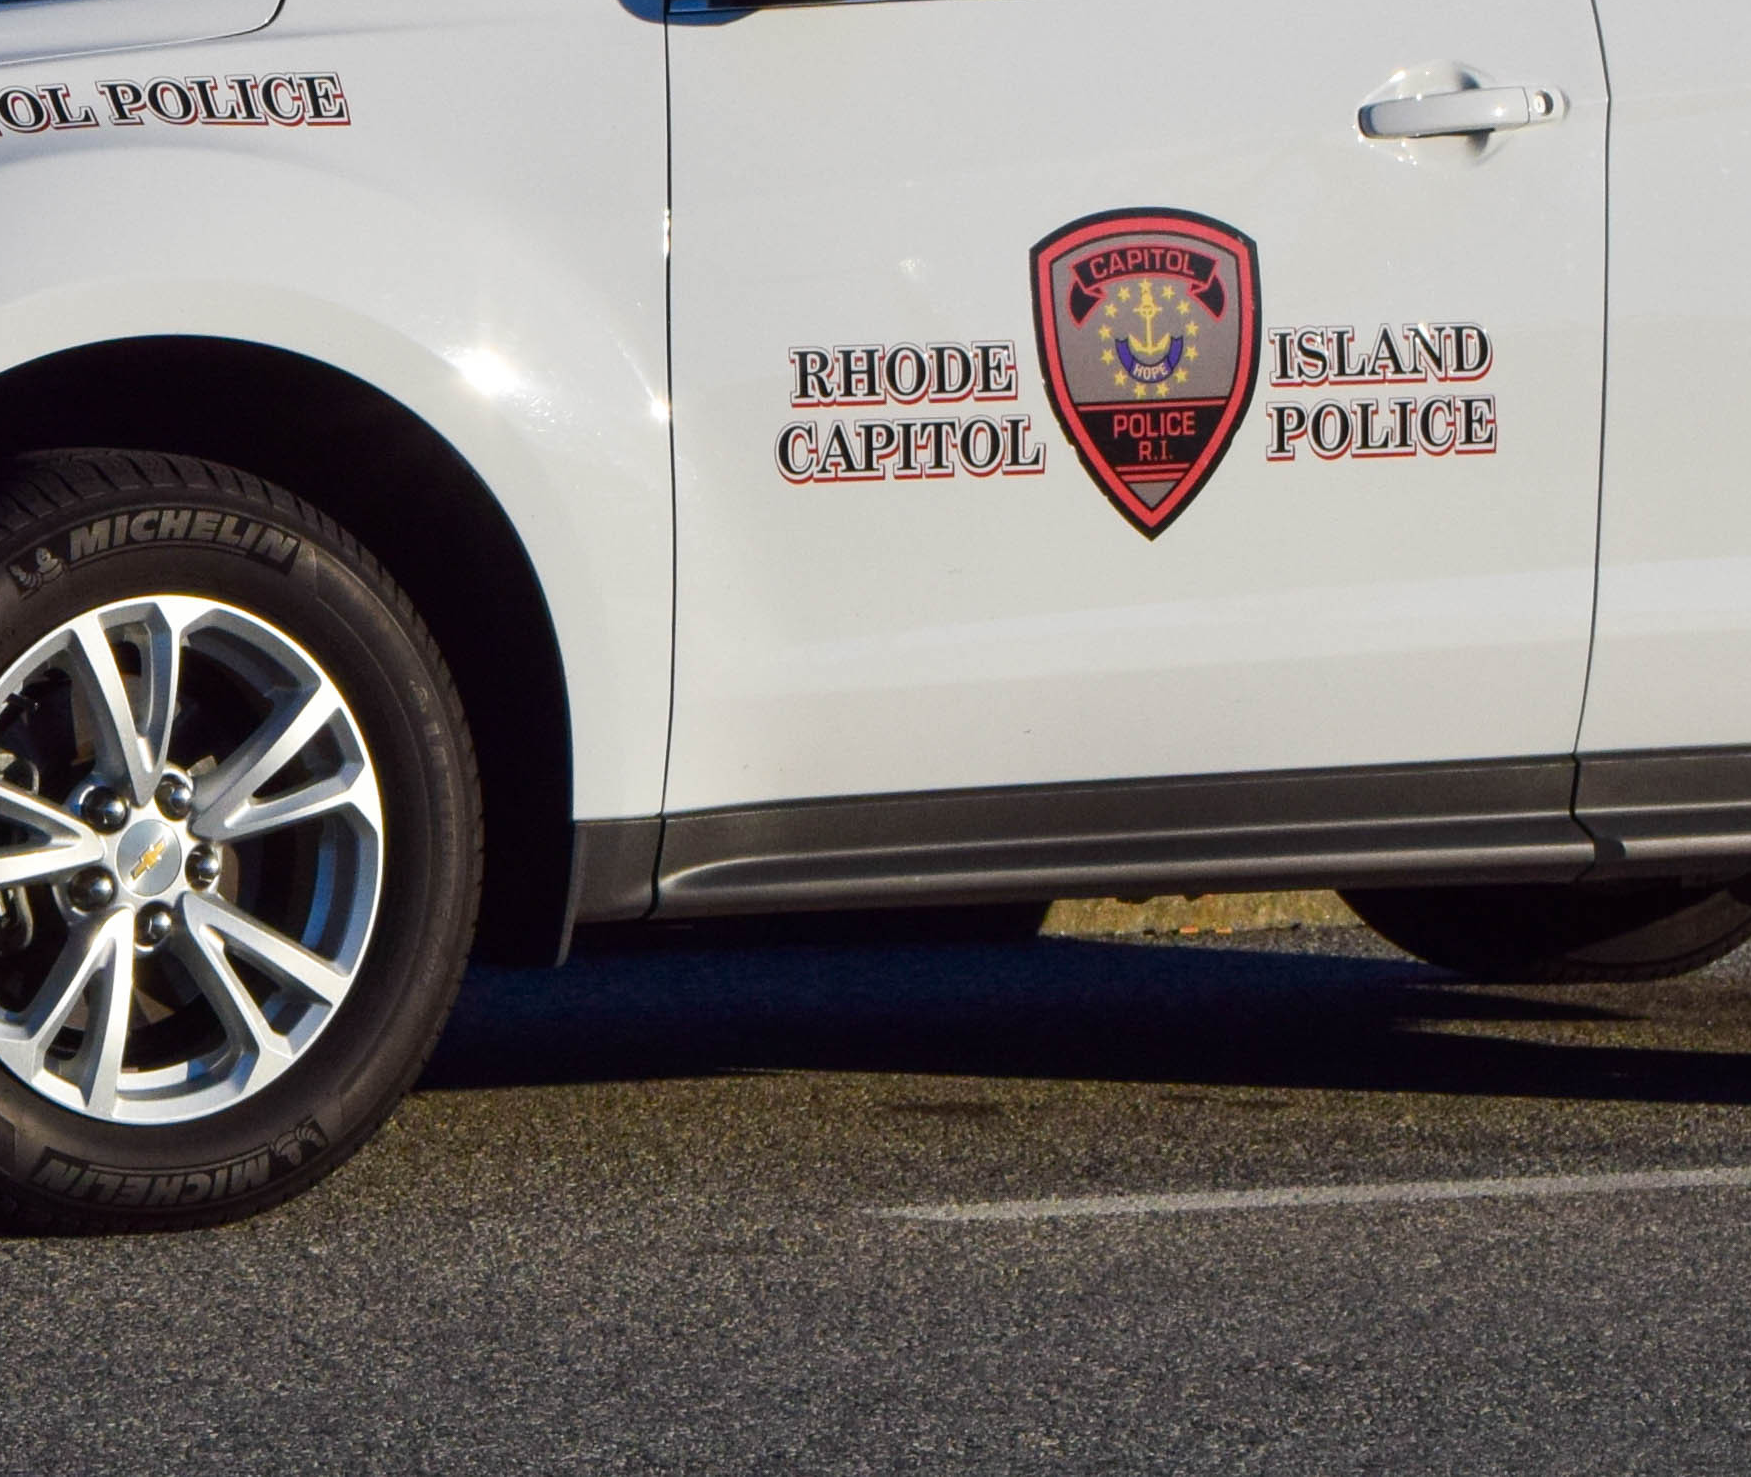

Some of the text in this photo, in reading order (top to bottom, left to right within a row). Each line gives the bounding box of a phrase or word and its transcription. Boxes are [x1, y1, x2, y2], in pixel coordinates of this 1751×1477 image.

[98, 72, 351, 126] POLICE
[1088, 246, 1199, 281] CAPITOL
[789, 338, 1018, 407] RHODE
[1132, 361, 1167, 382] HOPE
[1267, 322, 1493, 389] ISLAND
[774, 415, 1046, 484] CAPITOL
[1112, 409, 1197, 440] POLICE
[1138, 440, 1175, 463] R.I.
[1266, 394, 1498, 461] POLICE
[68, 507, 299, 571] MICHELIN
[36, 1153, 274, 1208] MICHELIN
